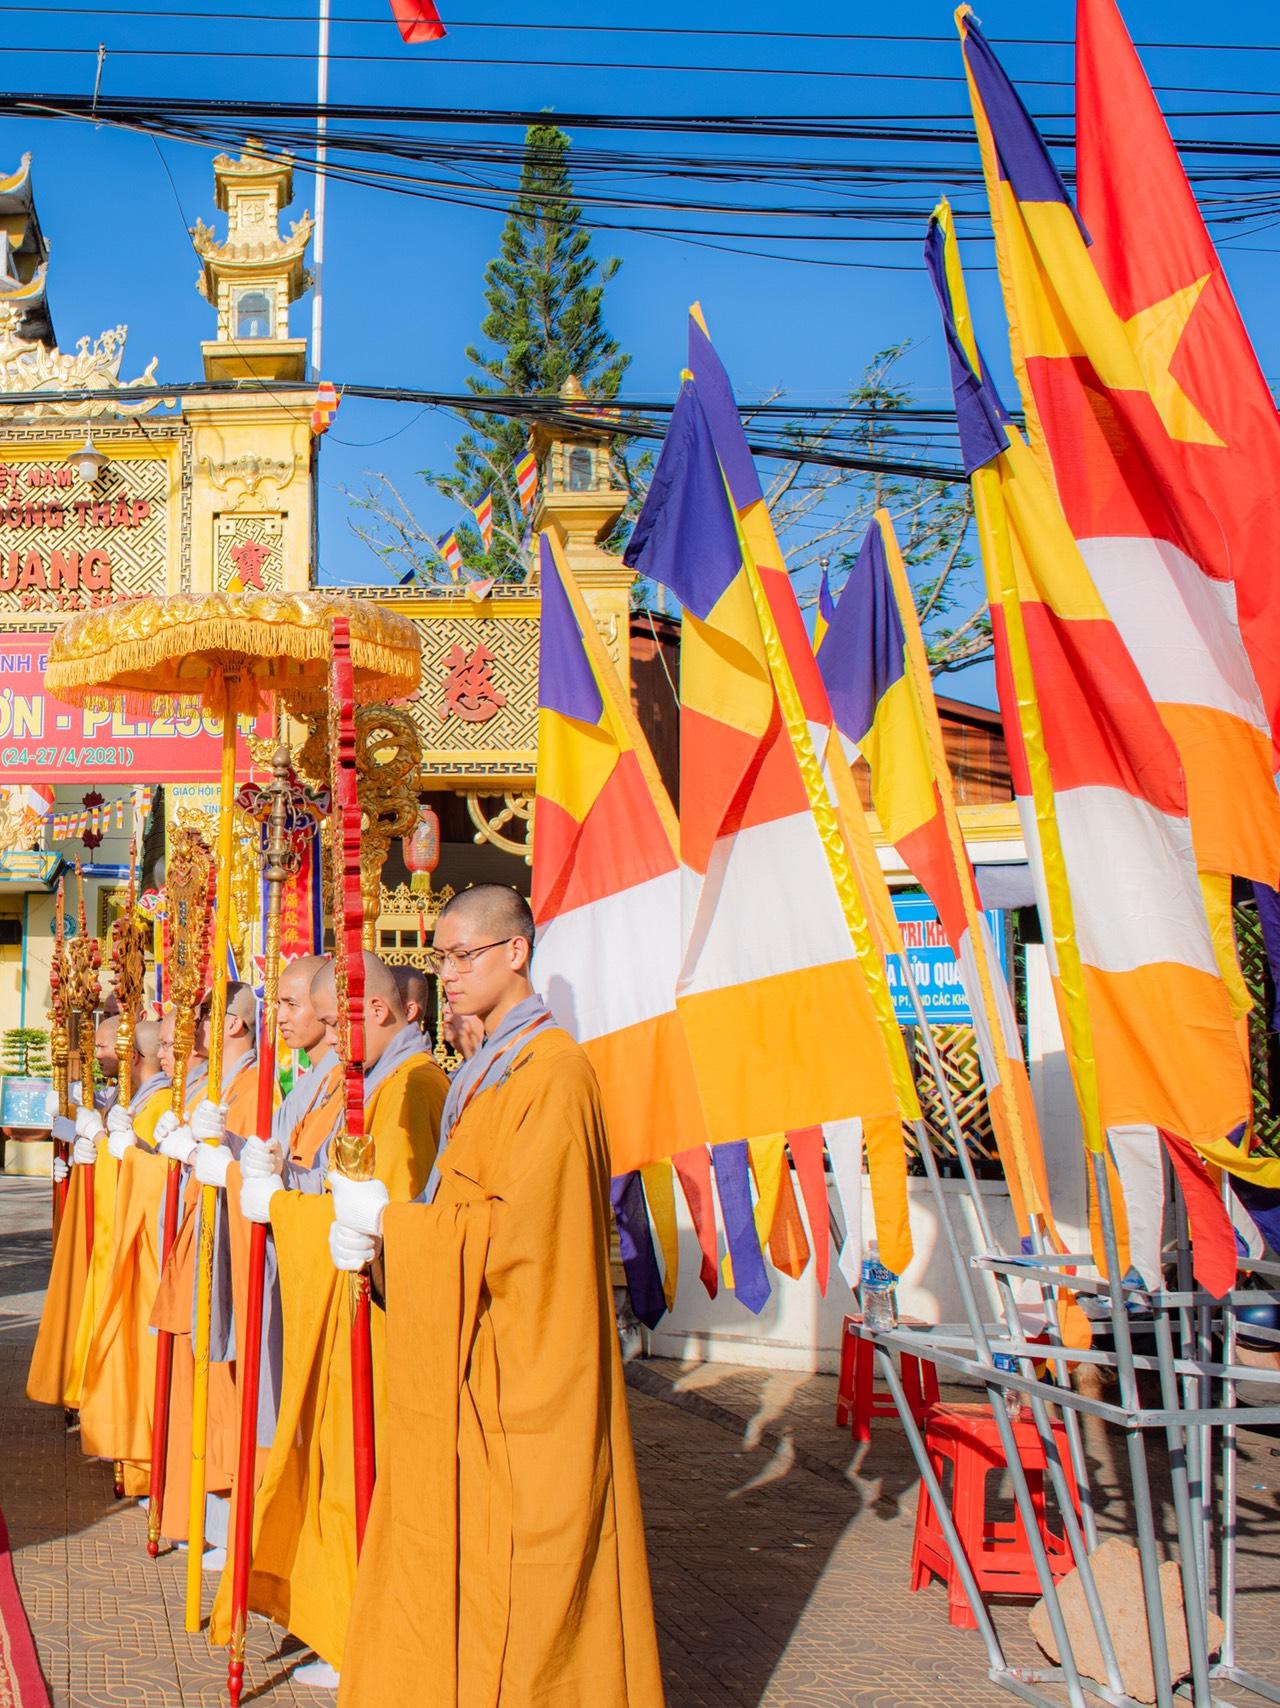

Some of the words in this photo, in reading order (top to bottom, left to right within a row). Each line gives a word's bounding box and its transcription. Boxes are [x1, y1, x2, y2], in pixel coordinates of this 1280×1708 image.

[28, 468, 73, 488] NAM
[73, 491, 150, 528] THÁP
[21, 594, 39, 610] P1
[1, 746, 134, 767] (24-27/4/2021)
[932, 990, 952, 1006] CÁC
